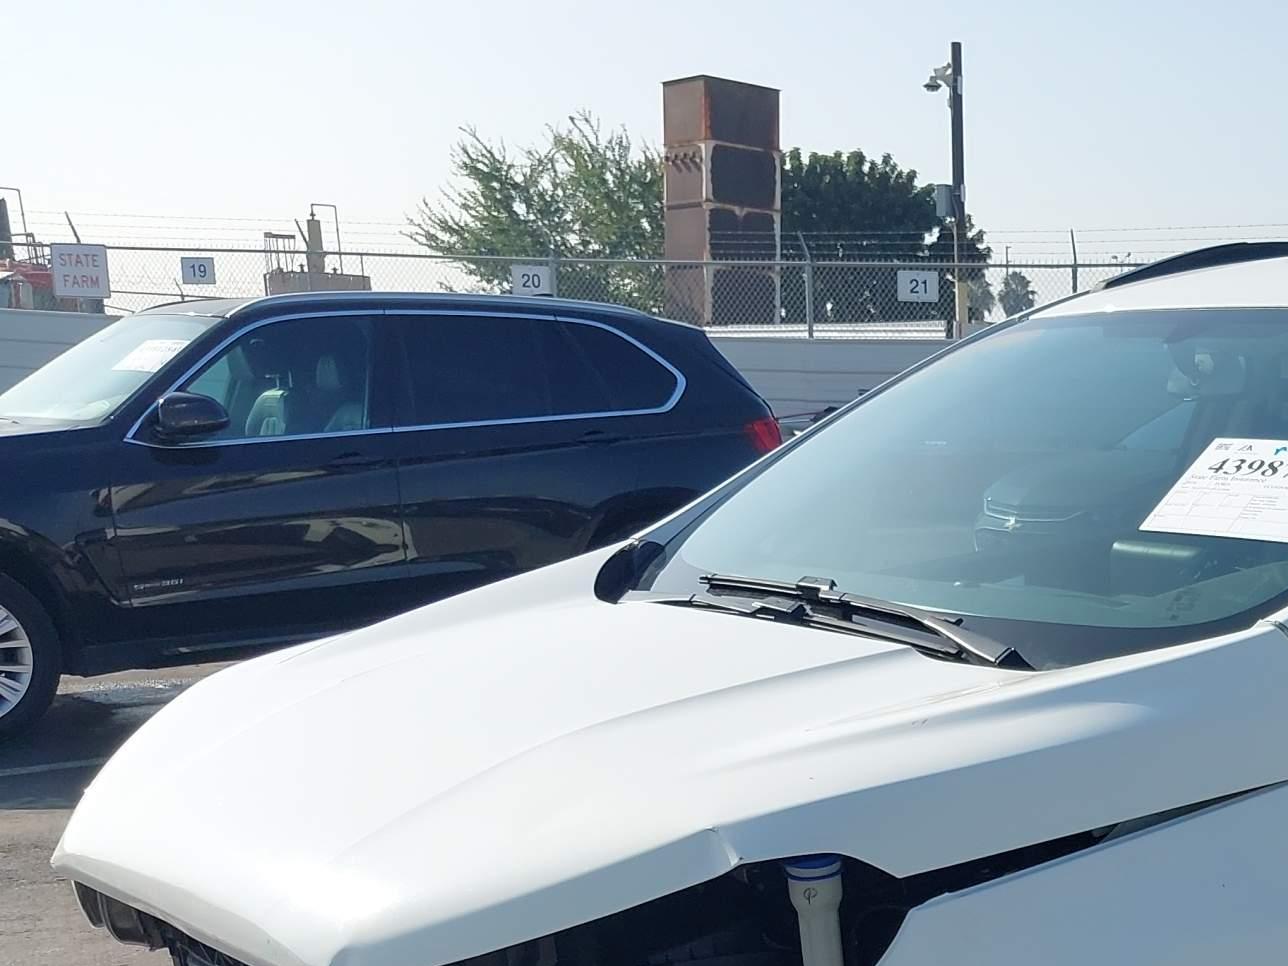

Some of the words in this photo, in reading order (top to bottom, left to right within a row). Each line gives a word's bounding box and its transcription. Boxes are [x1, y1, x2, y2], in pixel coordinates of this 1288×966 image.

[59, 253, 100, 268] STATE
[189, 263, 207, 279] 19
[63, 274, 100, 289] FARM
[521, 273, 541, 289] 20
[909, 278, 928, 295] 21
